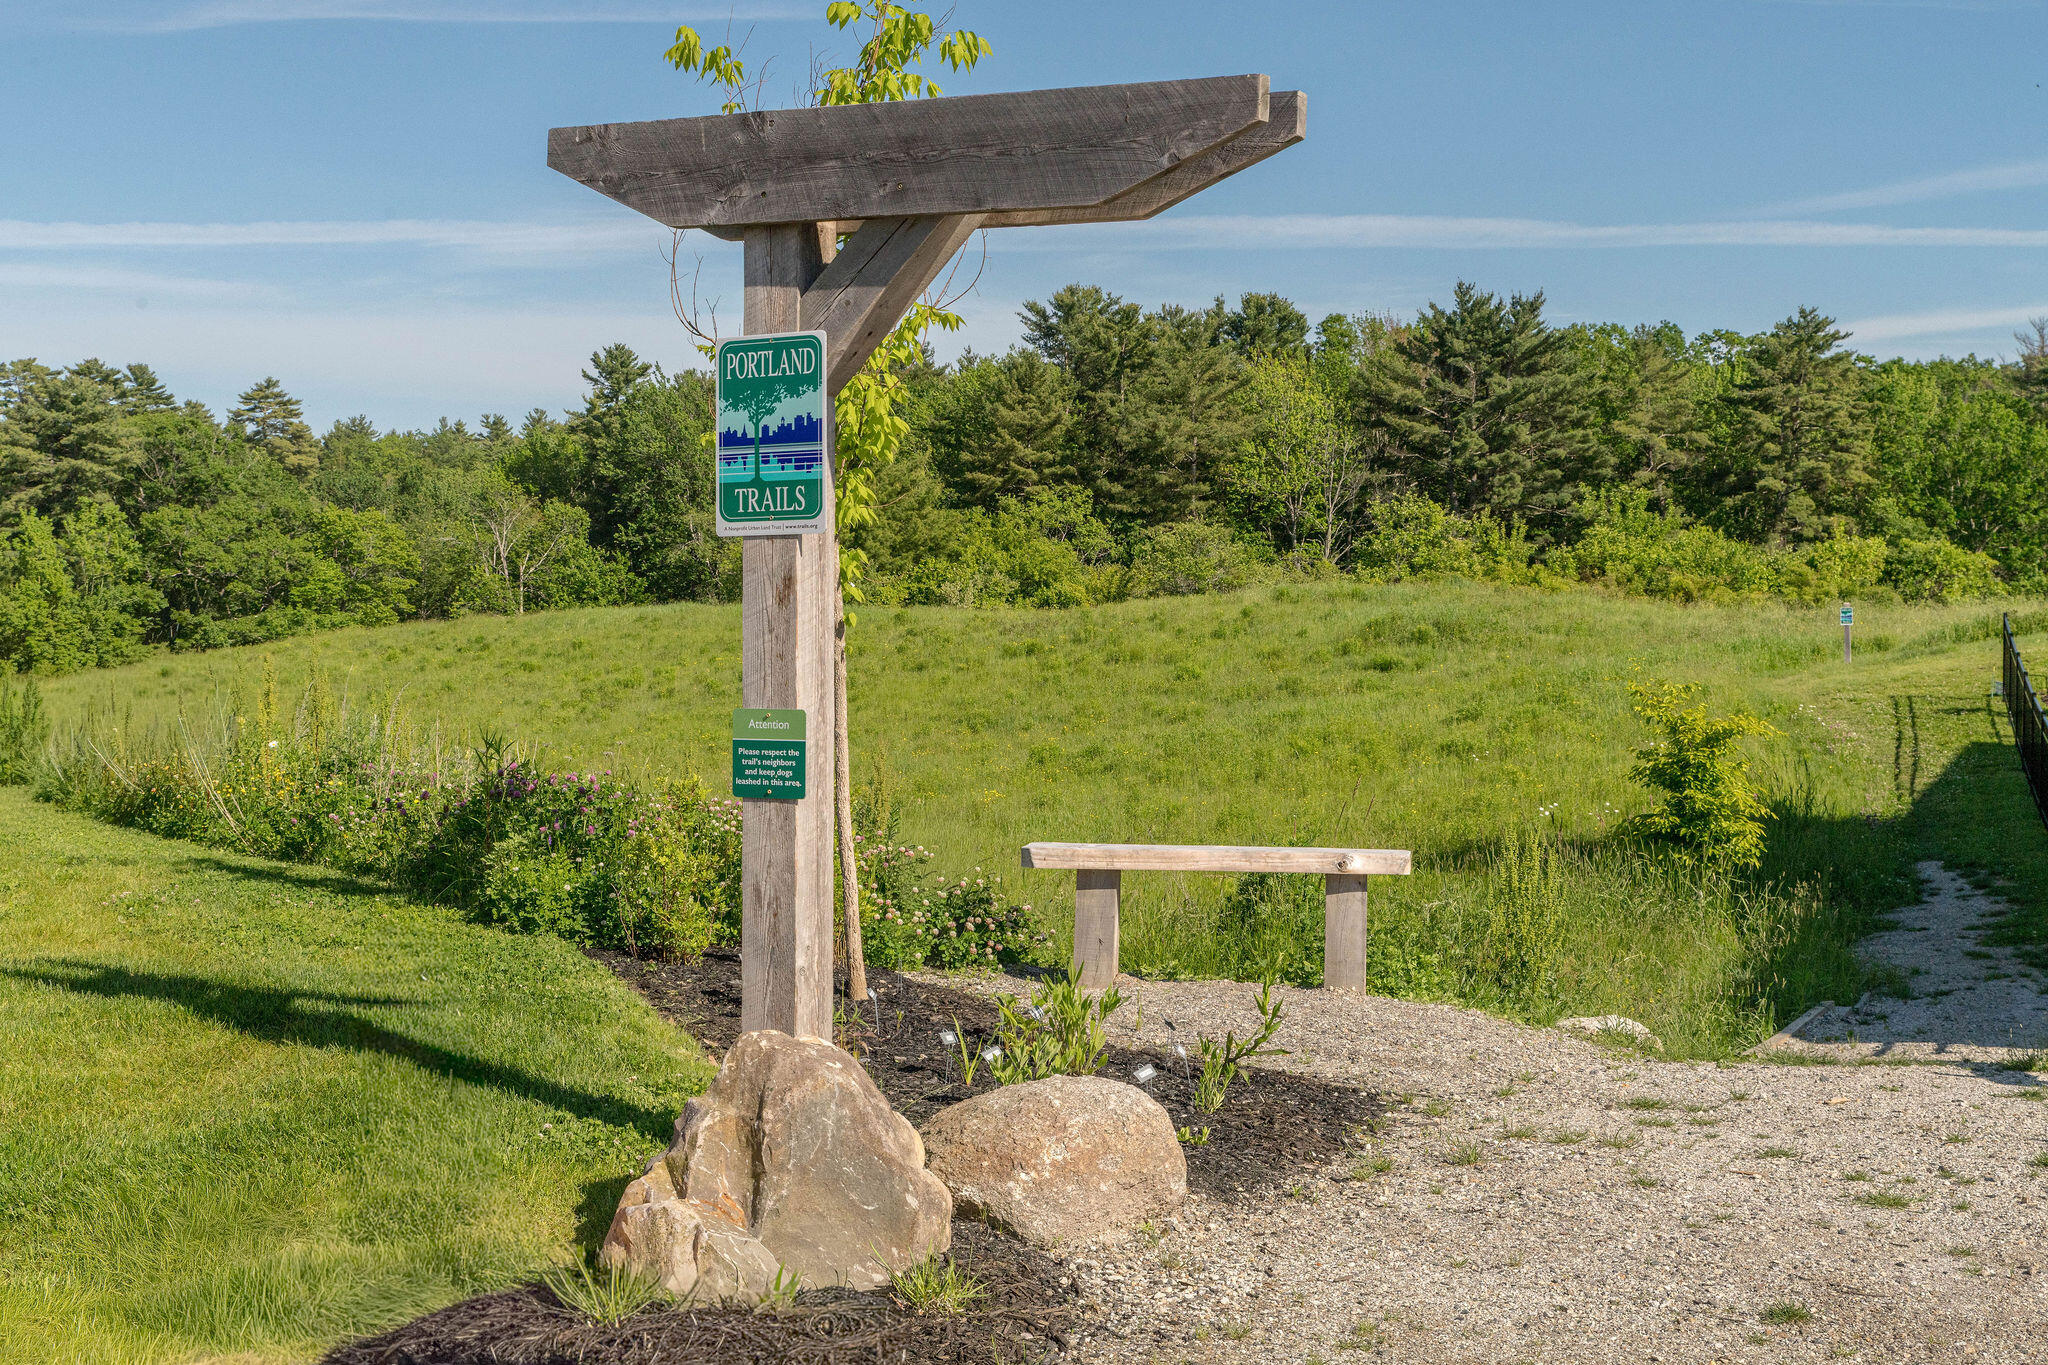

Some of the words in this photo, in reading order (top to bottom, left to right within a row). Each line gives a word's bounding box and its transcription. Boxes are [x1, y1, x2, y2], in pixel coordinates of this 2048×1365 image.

[726, 347, 815, 380] PORTLAND
[734, 485, 806, 513] TRAILS
[748, 720, 790, 729] Attention
[738, 747, 760, 756] Please
[761, 749, 787, 758] respect
[788, 749, 800, 757] the
[742, 758, 761, 766] trail's
[762, 758, 796, 768] neighbors
[758, 768, 776, 778] keep
[776, 769, 793, 778] dogs
[736, 777, 761, 786] leashed
[770, 778, 783, 786] this
